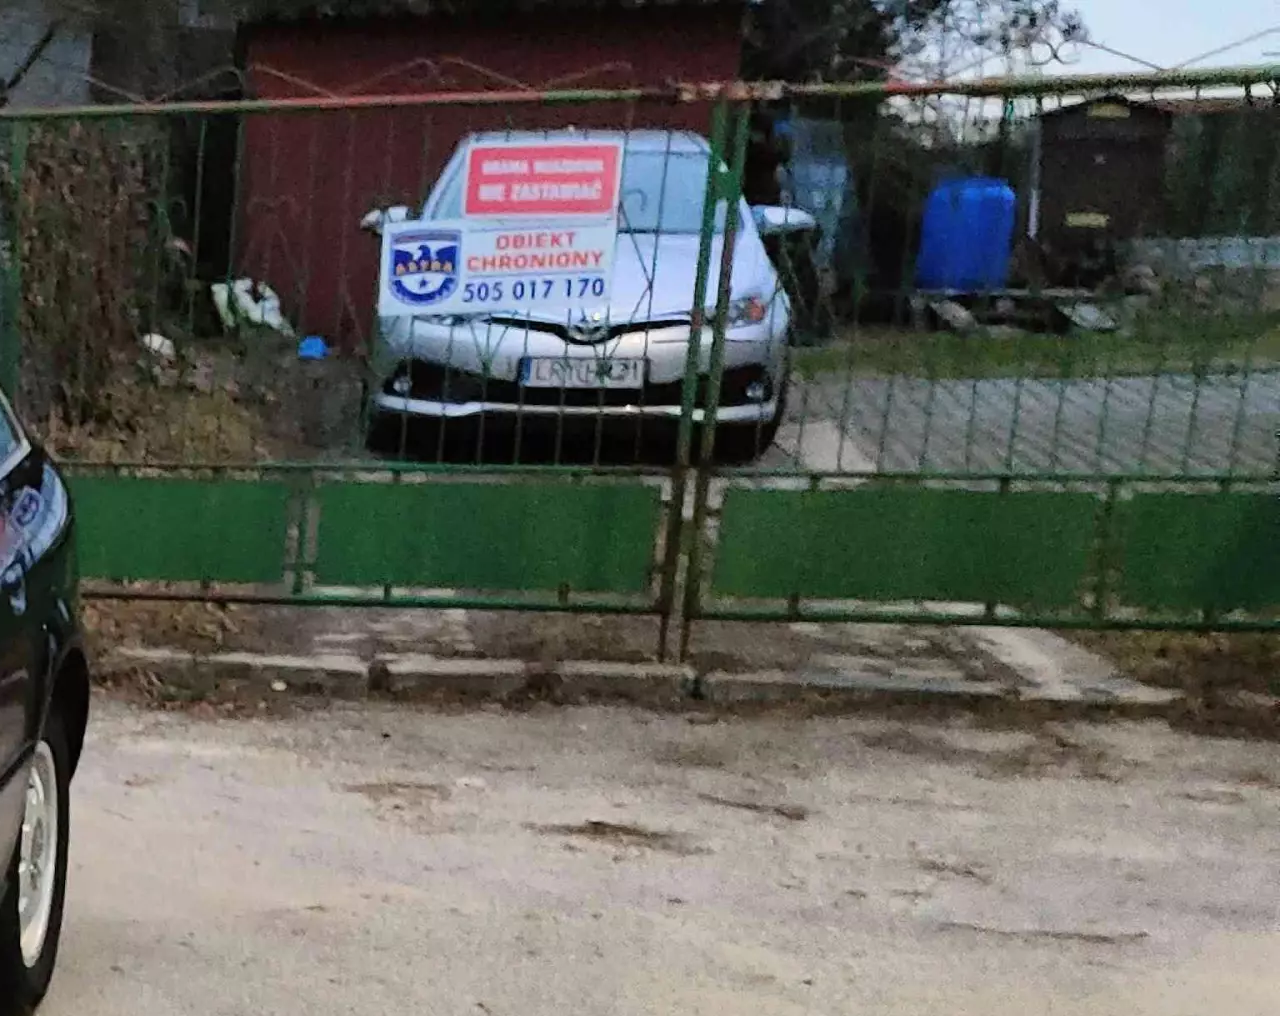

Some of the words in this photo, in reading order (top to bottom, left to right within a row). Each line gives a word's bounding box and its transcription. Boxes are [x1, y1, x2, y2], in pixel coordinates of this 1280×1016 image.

[496, 231, 576, 250] OBIEKT
[467, 251, 603, 272] CHRONIONY
[462, 281, 503, 302] 505
[512, 279, 555, 300] 017
[565, 277, 605, 297] 170
